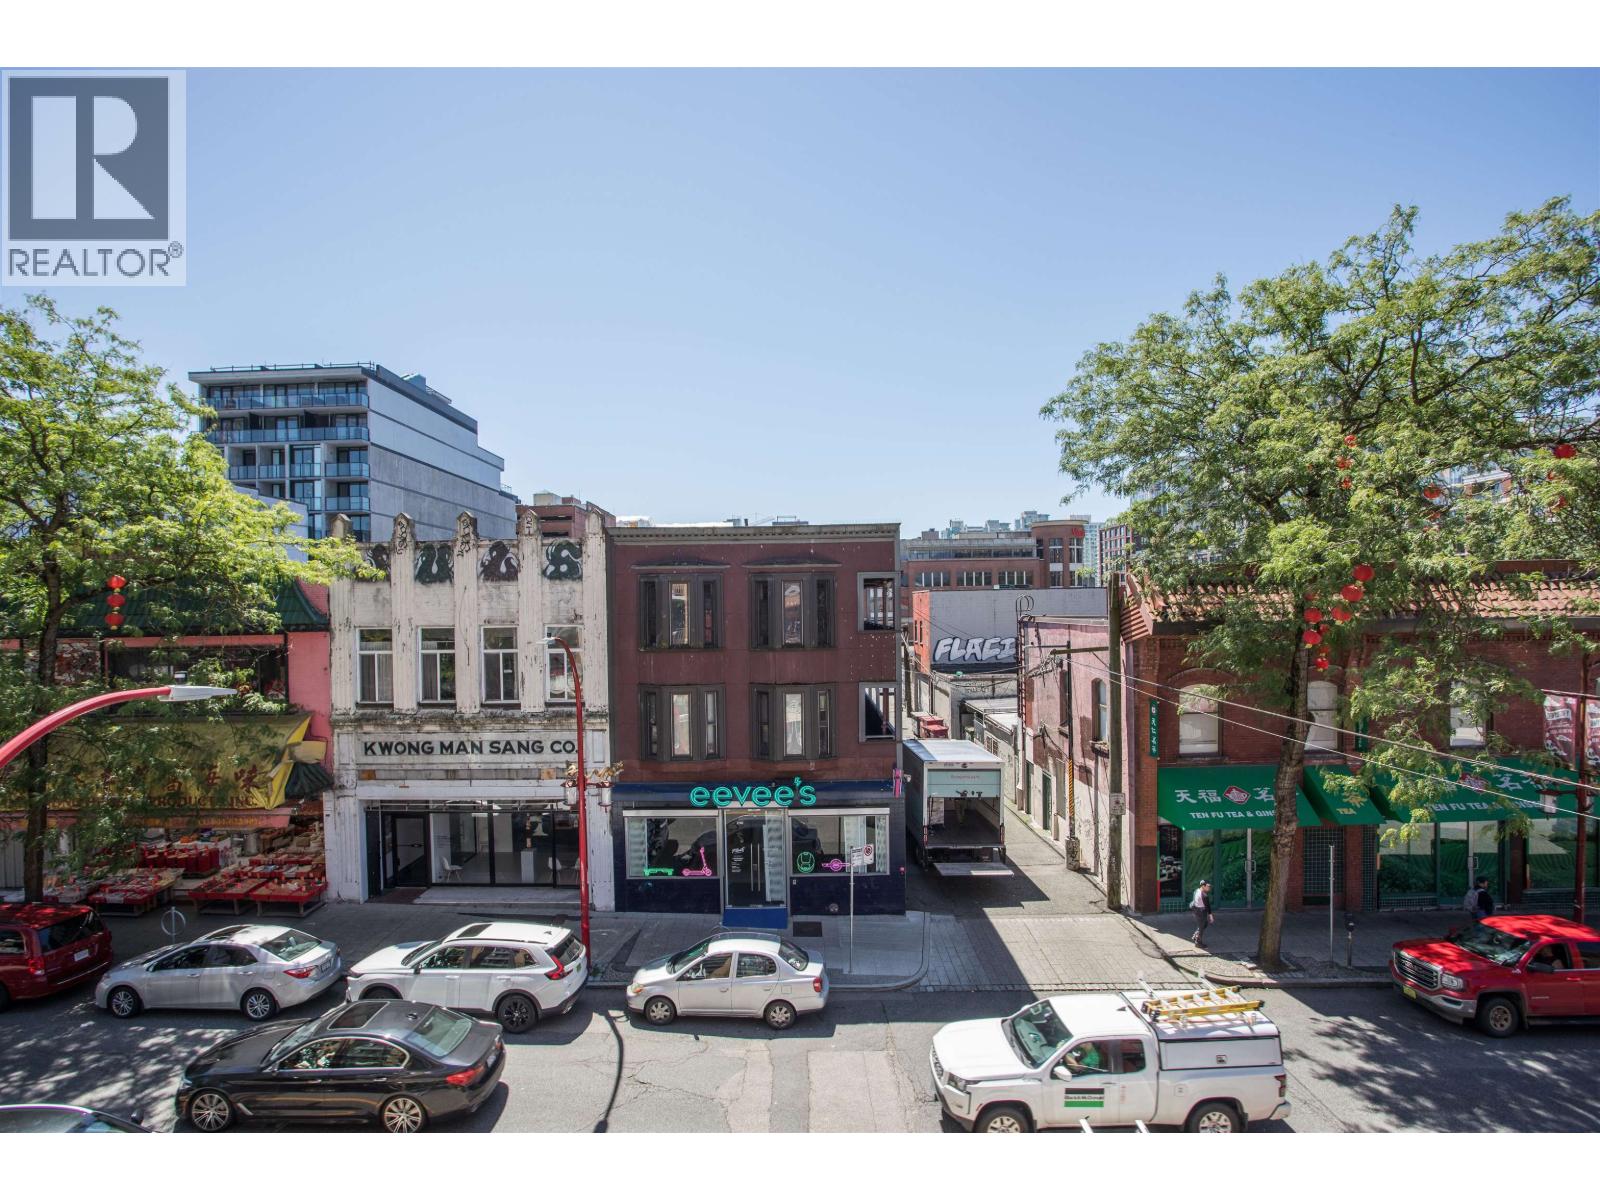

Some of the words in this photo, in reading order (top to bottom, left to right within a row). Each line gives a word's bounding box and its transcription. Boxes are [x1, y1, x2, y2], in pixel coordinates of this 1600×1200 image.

[364, 740, 435, 756] KWONG
[439, 740, 484, 755] MAN
[488, 740, 544, 755] SANG
[550, 740, 579, 755] CO.
[689, 776, 817, 807] eevee's
[1450, 803, 1466, 811] FU
